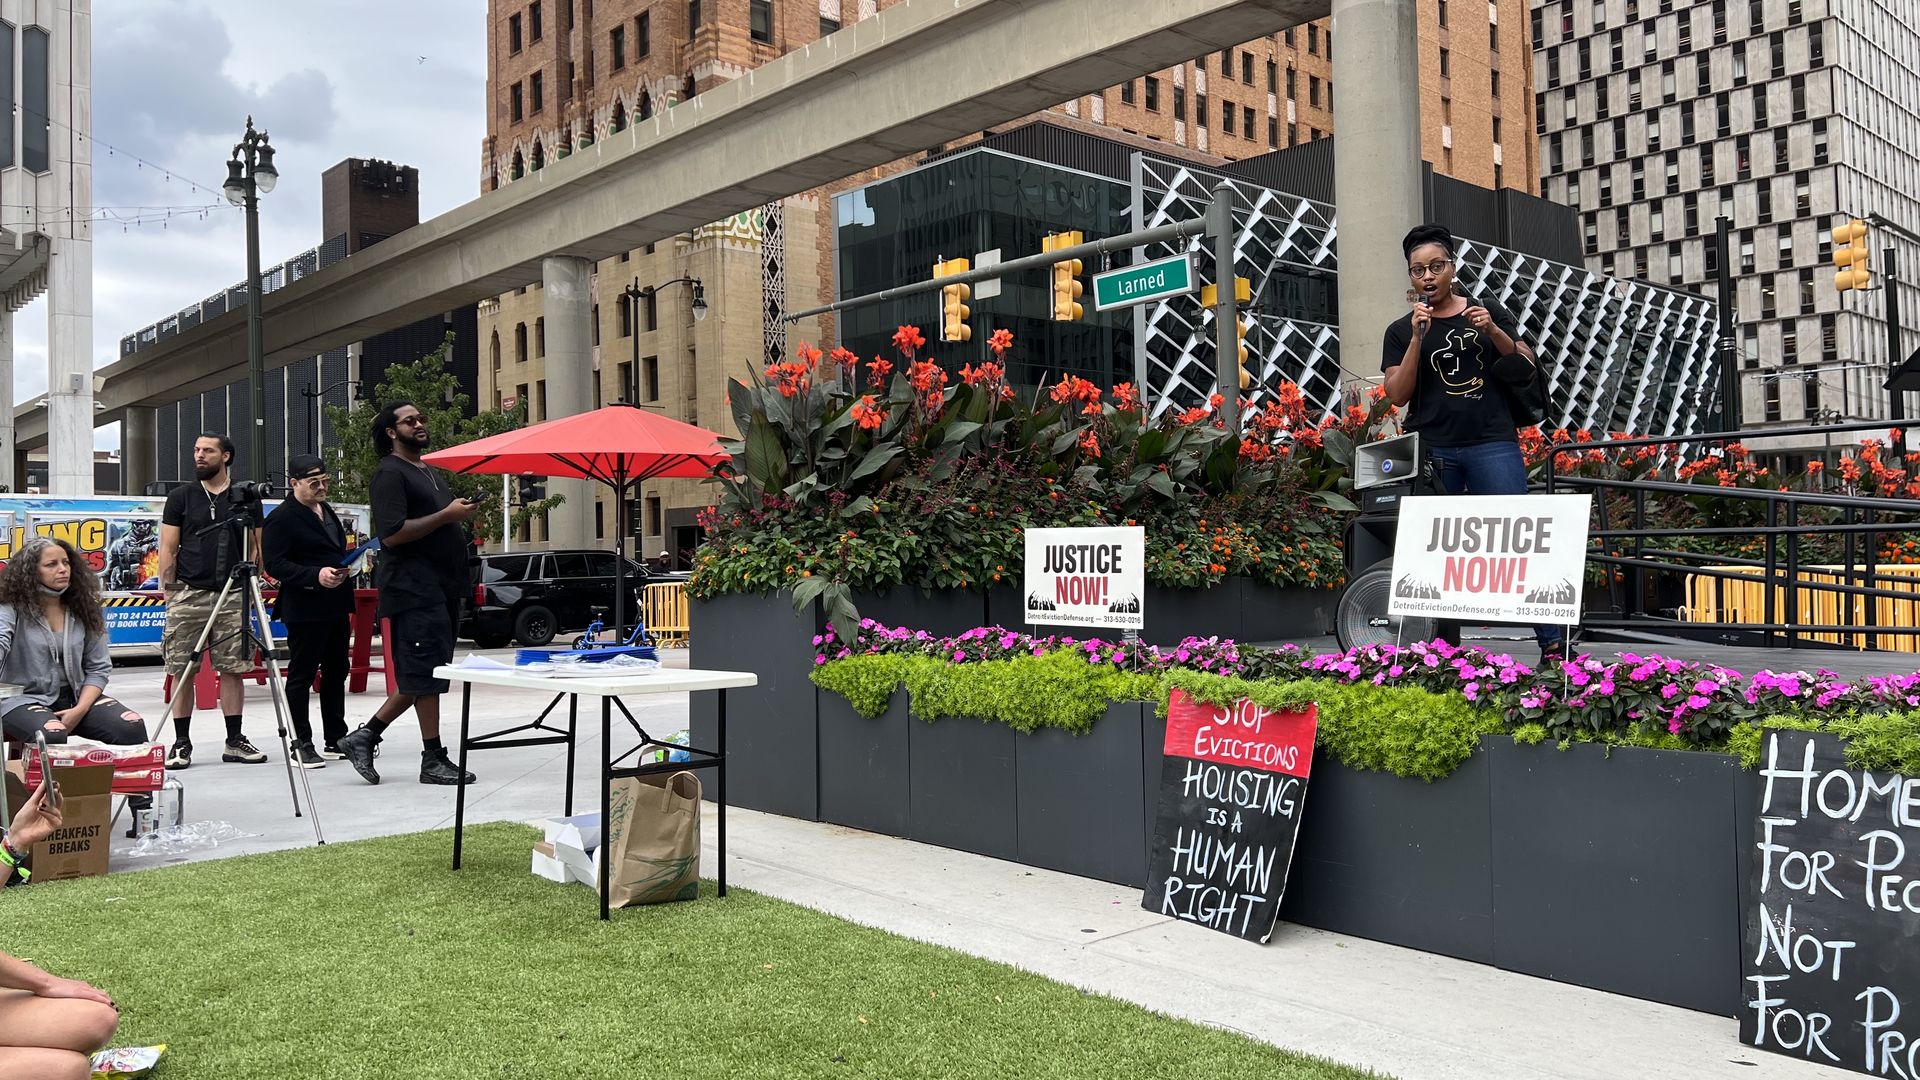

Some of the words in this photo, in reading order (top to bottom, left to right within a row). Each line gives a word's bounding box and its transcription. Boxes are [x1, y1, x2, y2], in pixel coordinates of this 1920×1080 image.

[1118, 270, 1165, 296] Larned
[1427, 516, 1553, 553] JUSTICE
[1043, 544, 1122, 574] JUSTICE
[1442, 556, 1528, 594] NOW!
[1055, 576, 1108, 606] NOW!
[106, 612, 118, 620] UP
[119, 612, 129, 620] TO
[130, 612, 141, 620] 24
[117, 620, 138, 628] BOOK
[1027, 612, 1094, 623] DetroitEvictionDefense.org
[1103, 615, 1141, 624] 313-530-0216
[1393, 601, 1500, 616] DetroitEvictionDefense.org
[1515, 607, 1576, 618] 313-530-0216
[1213, 697, 1271, 734] STOP
[151, 749, 163, 758] 18
[1194, 726, 1299, 770] EVICTIONS
[150, 771, 162, 780] 18
[1182, 760, 1299, 819] HOUSING
[1759, 733, 1920, 828] HOME
[40, 824, 101, 842] REAKFAST
[1206, 807, 1227, 826] IS
[1231, 811, 1242, 833] A
[49, 839, 91, 855] BREAKS
[1170, 826, 1276, 894] HUMAN
[1757, 816, 1847, 899] FOR
[1161, 876, 1266, 937] RIGHT
[1755, 902, 1856, 981] NOT
[1746, 974, 1840, 1062] FOR
